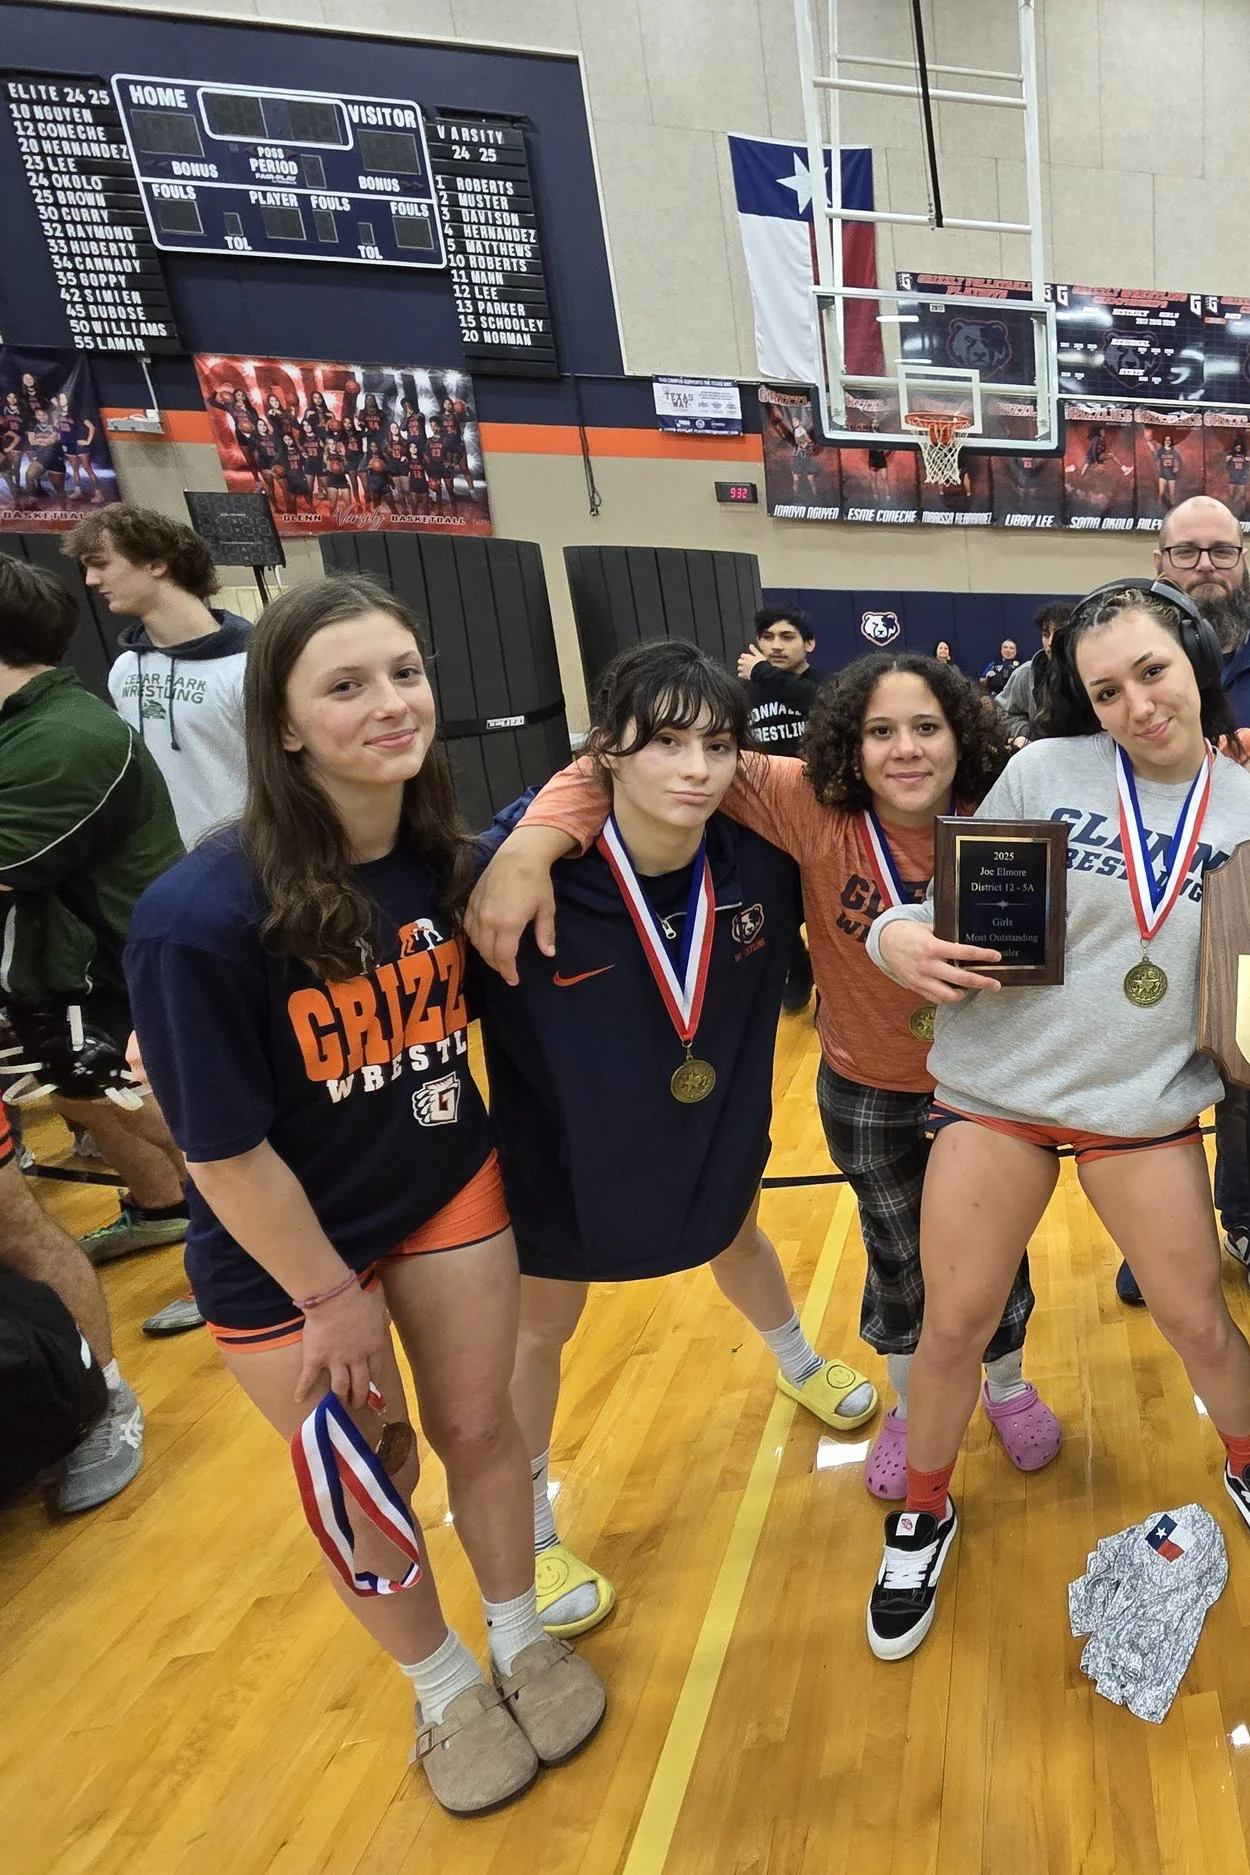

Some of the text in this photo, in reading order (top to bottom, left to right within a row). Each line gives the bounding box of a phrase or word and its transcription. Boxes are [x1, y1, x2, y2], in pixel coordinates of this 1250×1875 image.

[8, 83, 110, 105] ELITE 24 25
[129, 84, 188, 109] HOME
[10, 103, 93, 123] 10 NGUYEN
[348, 104, 417, 128] VISITOR
[14, 121, 107, 141] 12 CONECHE
[18, 137, 129, 159] 20 HERNANDEZ
[257, 146, 284, 159] POSS
[452, 145, 497, 162] 24 25
[22, 155, 77, 172] 23 LEE
[171, 160, 219, 178] BONUS
[249, 158, 298, 175] PERIOD
[27, 172, 102, 190] 24 OKOLO
[358, 175, 400, 192] BONUS
[435, 175, 514, 195] 1 ROBERTS
[32, 189, 106, 207] 25 BROWN
[152, 184, 198, 200] FOULS
[439, 191, 509, 210] 2 MUSTER
[249, 191, 351, 211] PLAYER FOULS
[38, 205, 109, 223] 30 CURRY
[390, 202, 430, 218] FOULS
[441, 207, 520, 226] 3 DAVISON
[42, 222, 133, 241] 32 RAYMOND
[444, 222, 537, 243] 4 HERNANDEZ
[47, 239, 136, 257] 33 HUBERTY
[224, 236, 252, 251] TOL
[447, 238, 532, 258] 5 MATTHEWS
[357, 245, 383, 260] TOL
[51, 255, 140, 273] 34 CANNADY
[448, 254, 527, 272] 10 ROBERTS
[56, 271, 77, 285] 35
[451, 269, 504, 285] 11 MANN
[60, 288, 142, 304] 42 SIMIEN
[453, 285, 499, 300] 12 LEE
[66, 304, 146, 320] 45 DUBOSE
[456, 300, 526, 317] 13 PARKER
[69, 320, 167, 336] 50 WILLIAMS
[459, 315, 544, 332] 15 SCHOOLEY
[74, 336, 145, 351] 55 LAMAR
[461, 330, 532, 346] 20 NORMAN
[390, 514, 466, 526] BASKETBALL
[165, 674, 207, 692] PARK
[122, 684, 204, 704] WRESTLING
[993, 851, 1015, 861] 2025
[979, 867, 1027, 877] Joe Elmore
[971, 882, 1035, 892] District 12 5A
[992, 918, 1013, 927] Girls
[965, 933, 1039, 944] Most Outstanding
[287, 937, 468, 1082] GRIZZ
[327, 1030, 467, 1103] WRESTL
